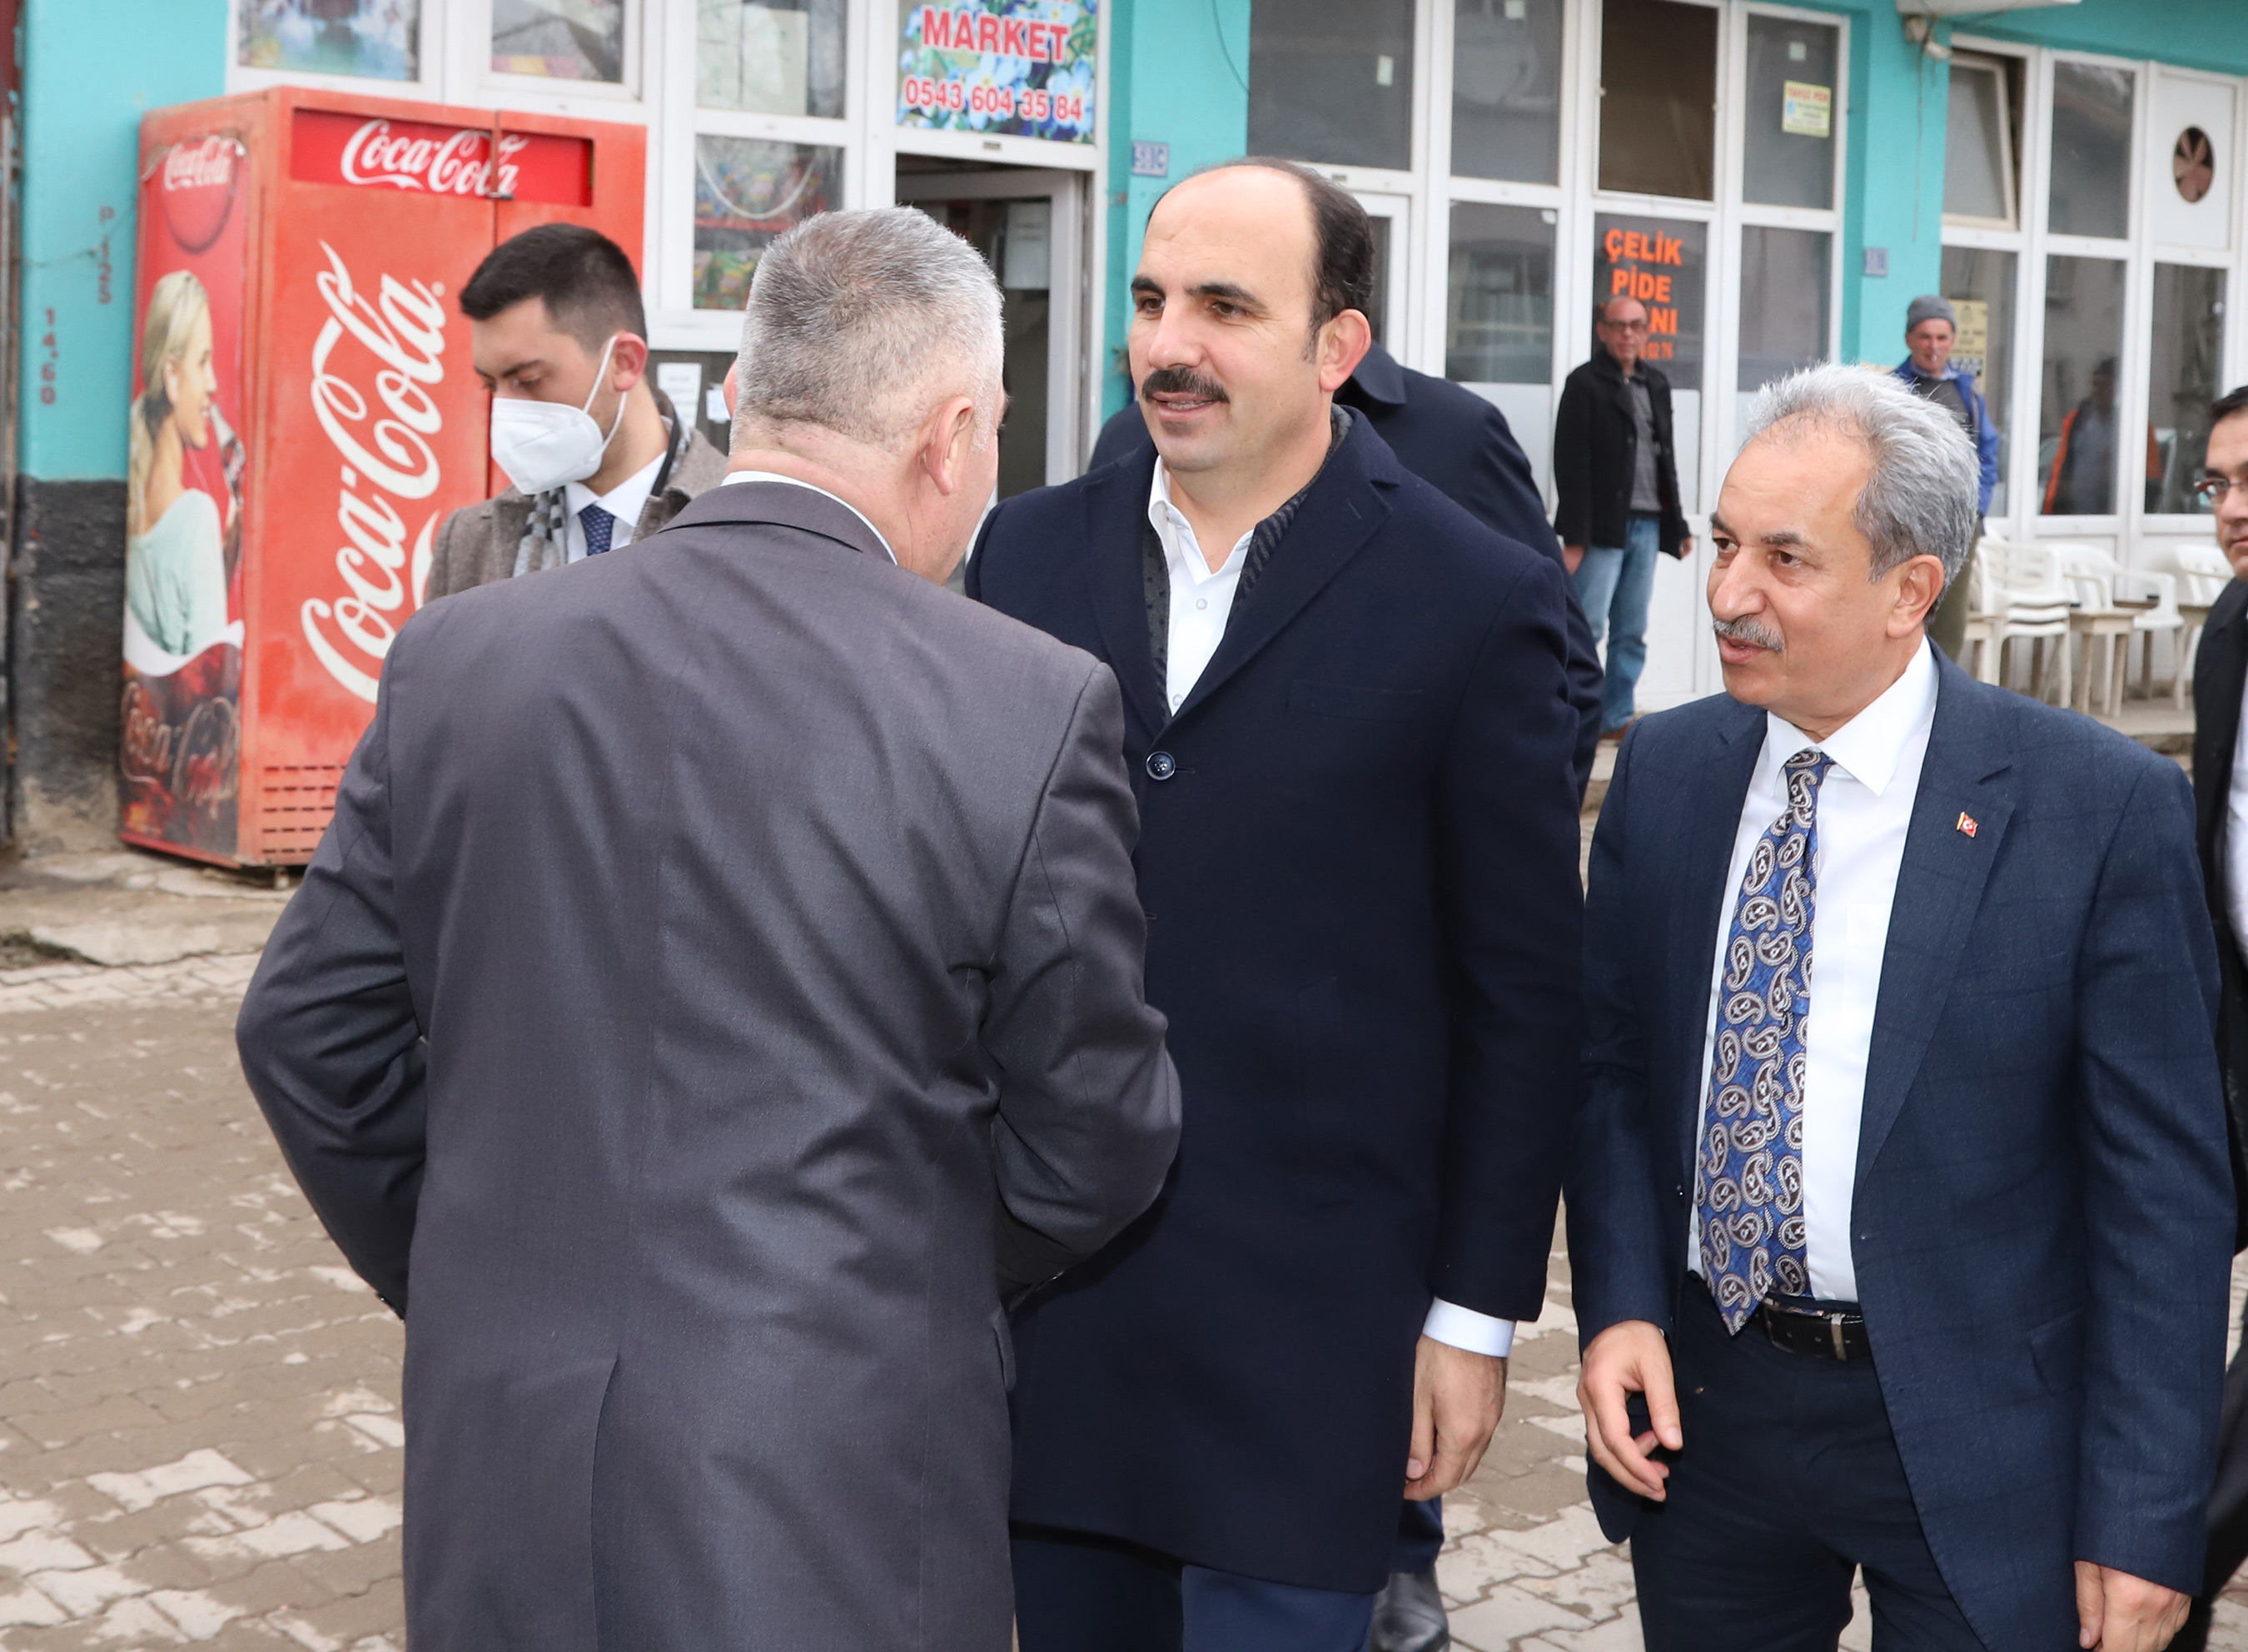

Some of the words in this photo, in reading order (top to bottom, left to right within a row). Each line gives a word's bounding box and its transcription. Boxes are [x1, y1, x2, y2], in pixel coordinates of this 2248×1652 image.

[923, 9, 1069, 61] MARKET
[906, 79, 962, 109] 0543
[971, 87, 1013, 113] 604
[1021, 90, 1048, 118] 35
[1055, 95, 1082, 121] 84
[341, 119, 530, 196] Coca-Cola
[1605, 229, 1683, 266] ÇELİK
[1612, 265, 1672, 303] PİDE
[301, 239, 446, 704] Coca-Cola
